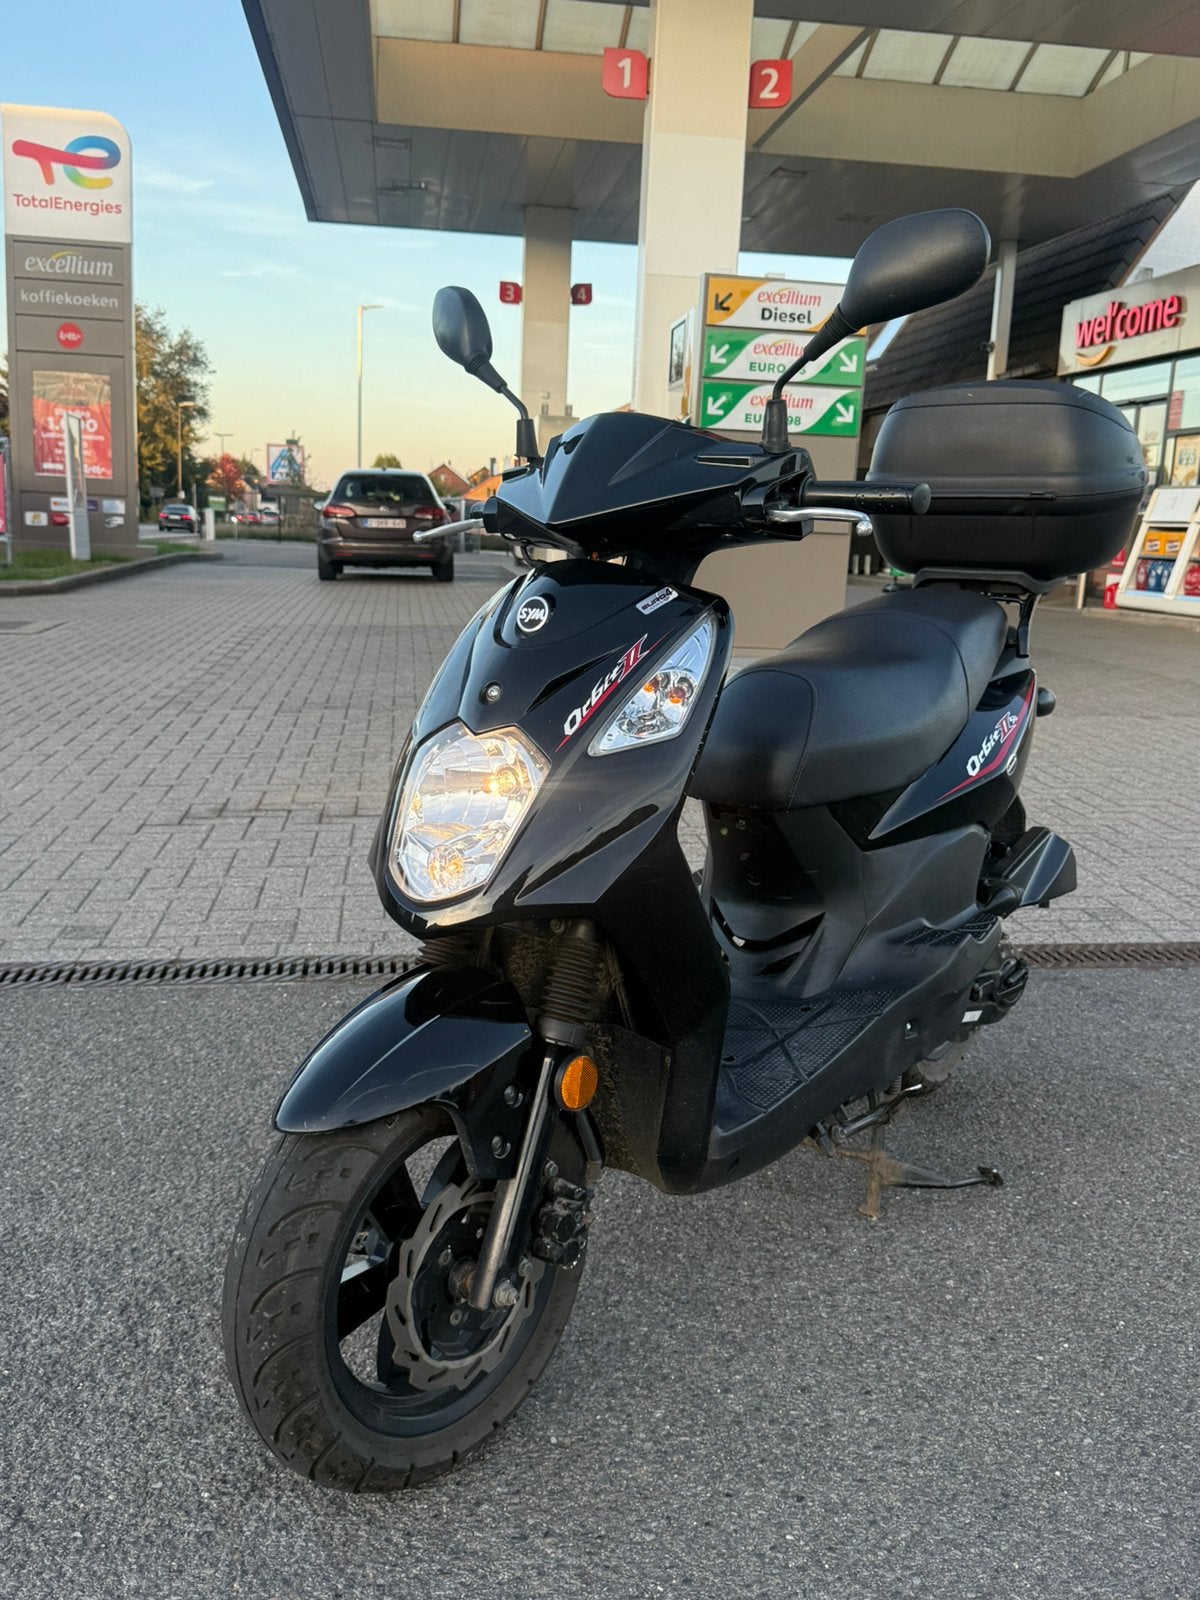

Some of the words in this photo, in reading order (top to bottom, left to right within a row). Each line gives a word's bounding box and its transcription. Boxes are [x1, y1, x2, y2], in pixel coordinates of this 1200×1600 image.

[616, 57, 632, 89] 1
[758, 68, 780, 99] 2
[13, 193, 122, 216] TotalEnergies
[25, 254, 113, 276] excellium
[20, 288, 119, 309] koffiekoeken
[503, 285, 515, 300] 3
[575, 286, 587, 300] 4
[757, 288, 822, 307] excellium
[761, 307, 812, 324] Diesel
[753, 342, 804, 357] excelliu
[749, 361, 787, 374] EURO
[750, 393, 814, 410] exlium
[786, 415, 802, 426] 98
[519, 607, 545, 622] SYM
